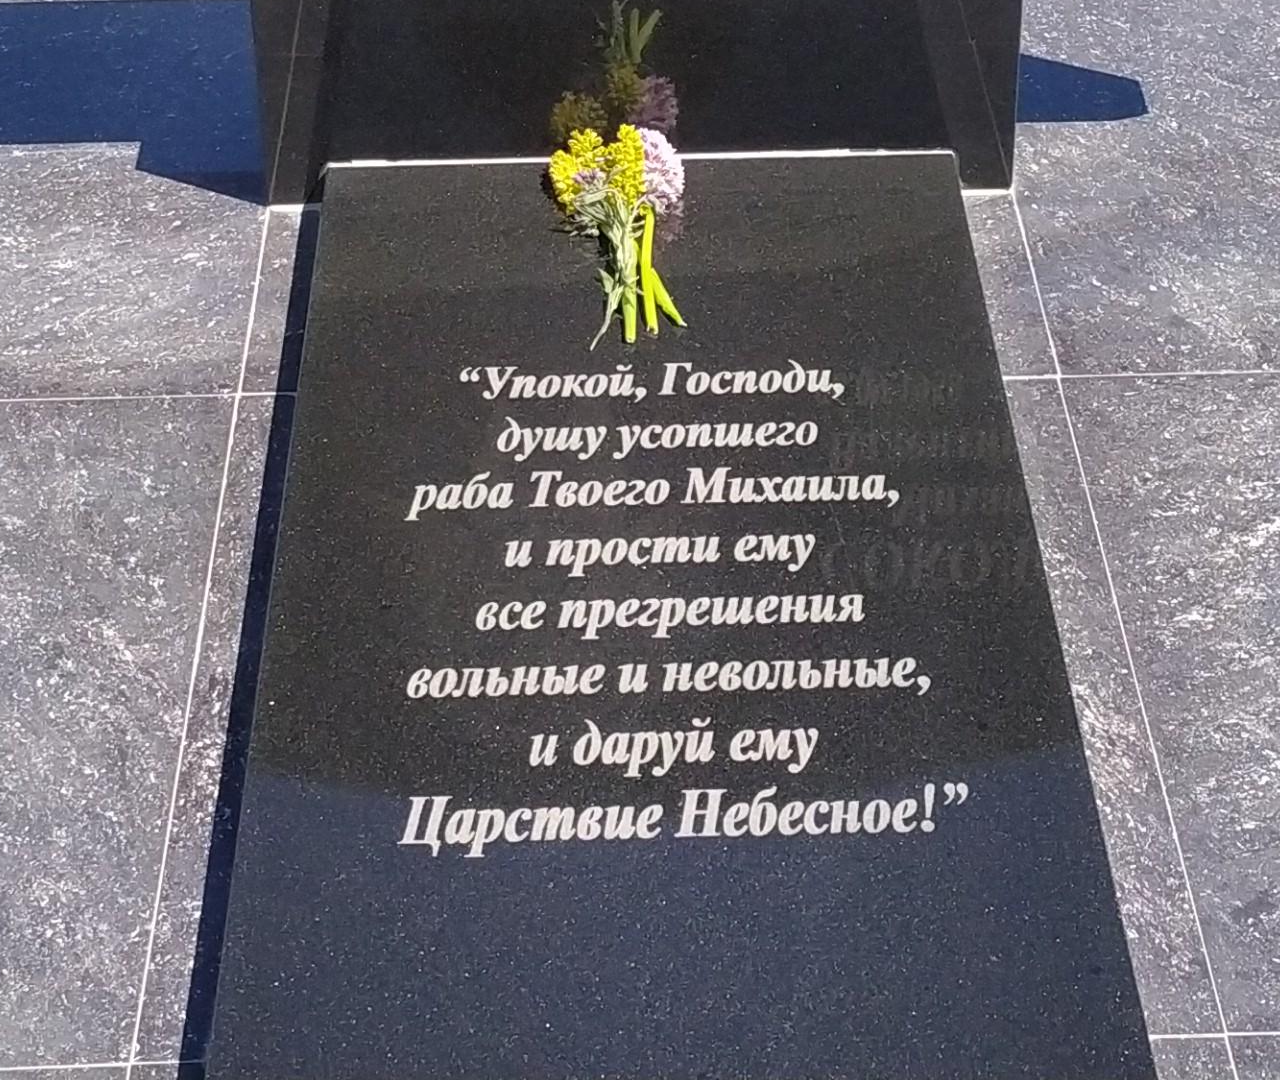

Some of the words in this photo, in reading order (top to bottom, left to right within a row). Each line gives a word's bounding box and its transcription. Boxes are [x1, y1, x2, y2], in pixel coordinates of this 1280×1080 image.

[658, 359, 845, 406] Господи,
[496, 416, 605, 462] душу
[609, 421, 819, 461] усопшего
[404, 471, 514, 522] раба
[528, 470, 671, 509] Твоего
[681, 466, 901, 508] Михаила,
[504, 539, 533, 569] и
[545, 535, 721, 579] прости
[733, 533, 816, 573] ему
[475, 600, 547, 632] все
[557, 594, 866, 641] прегрешения
[406, 663, 606, 699] вольные
[617, 663, 649, 694] и
[662, 657, 932, 696] невольные,
[528, 733, 560, 768] и
[572, 716, 716, 778] даруй
[729, 727, 819, 774] ему
[396, 795, 664, 858] Царствие
